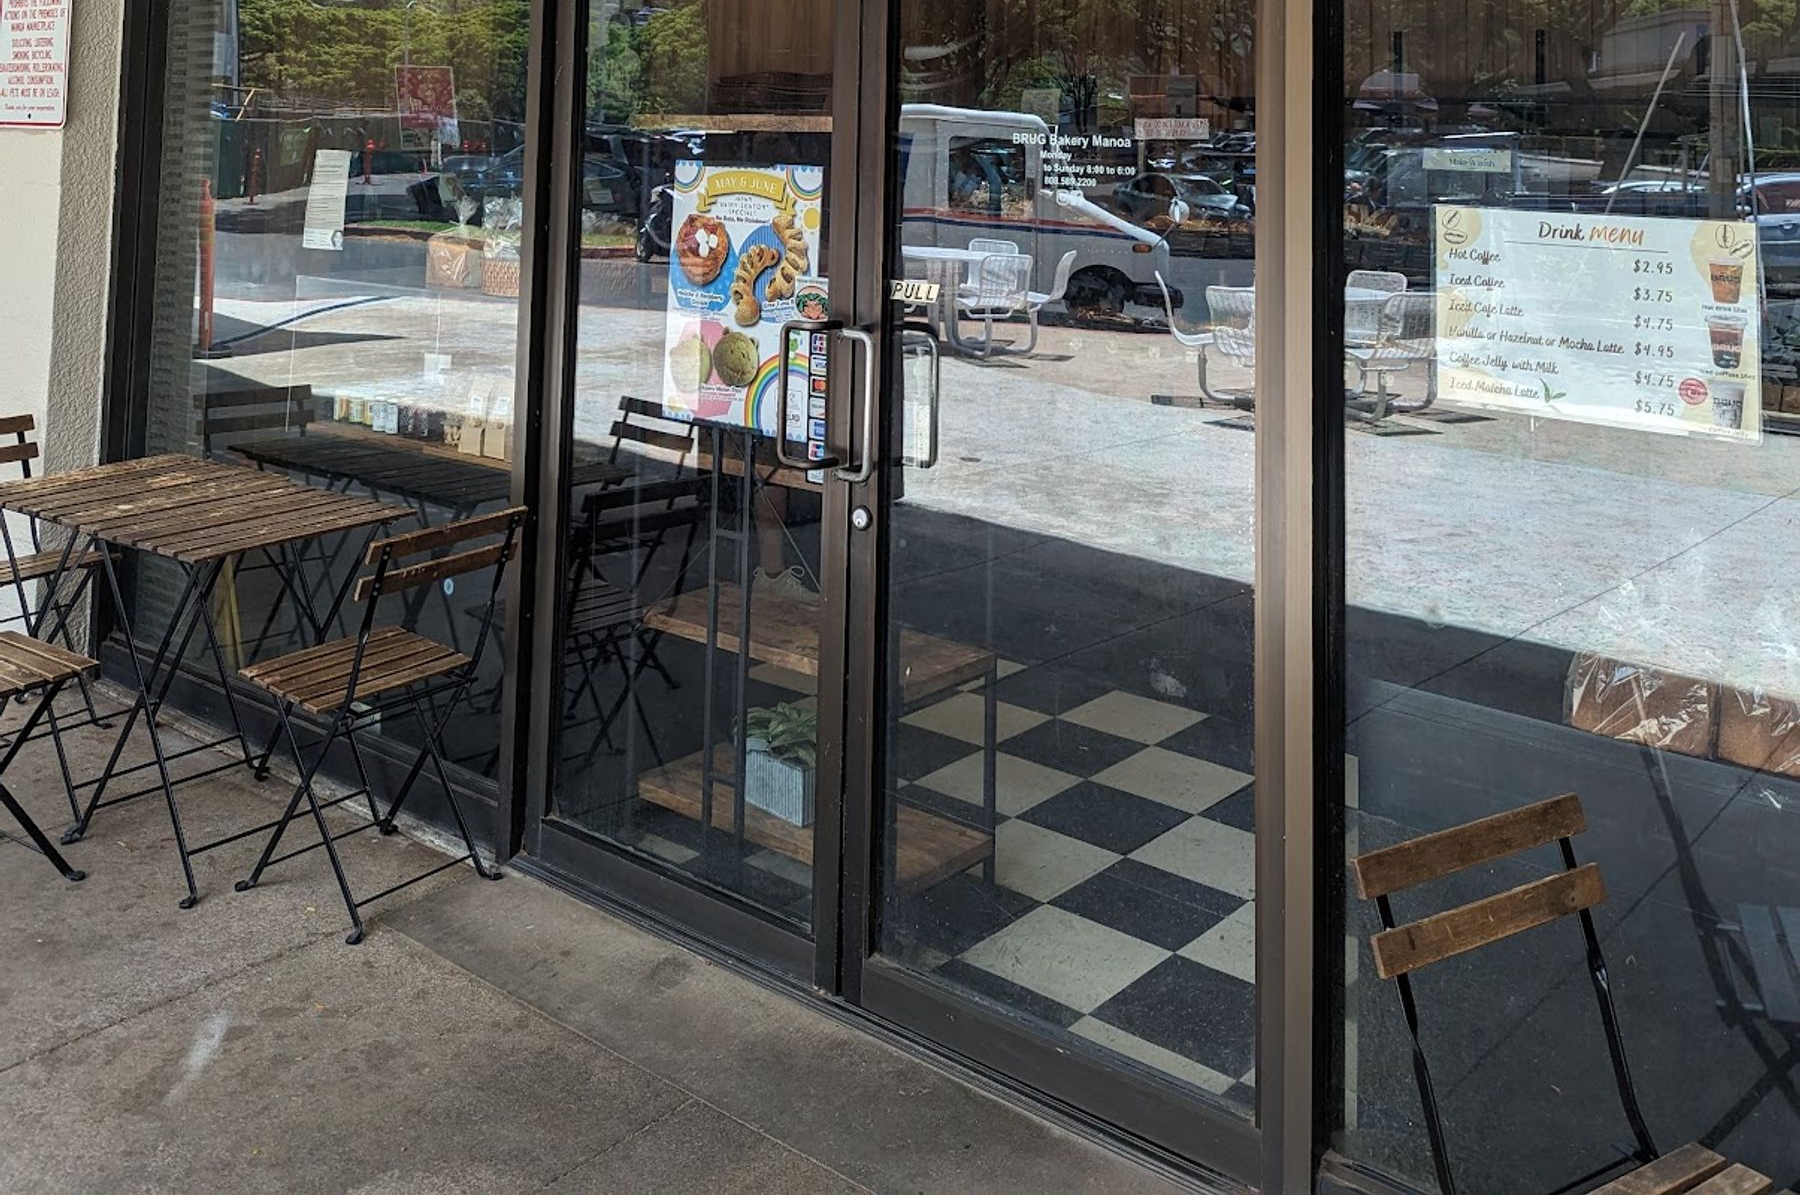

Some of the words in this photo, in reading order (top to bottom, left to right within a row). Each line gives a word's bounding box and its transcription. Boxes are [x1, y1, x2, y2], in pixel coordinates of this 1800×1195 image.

[1012, 133, 1047, 145] BRUG
[1049, 134, 1089, 149] Bakery
[1092, 135, 1132, 148] Manoa
[1040, 150, 1072, 161] Monday
[1043, 164, 1052, 172] to
[1053, 163, 1085, 175] Sunday
[1106, 166, 1115, 175] to
[715, 177, 737, 190] MAY
[740, 176, 747, 187] &
[751, 178, 777, 194] JUNE
[1538, 221, 1585, 241] Drink
[1588, 222, 1644, 246] menu
[1448, 248, 1468, 260] Hot
[1469, 249, 1501, 265] Coffee
[1633, 258, 1673, 275] $2.95
[1448, 273, 1473, 286] Iced
[1474, 275, 1506, 291] Coffee
[891, 282, 935, 302] PULL
[1633, 286, 1673, 303] $3.75
[1448, 299, 1473, 312] Iced
[1499, 305, 1525, 317] Latte
[1633, 314, 1673, 331] $4.75
[1449, 325, 1484, 339] Vanilla
[1487, 332, 1496, 340] or
[1500, 330, 1544, 346] Hazelnut
[1545, 338, 1556, 346] or
[1558, 337, 1595, 351] Mocha
[1597, 340, 1625, 354] Latte
[1634, 341, 1675, 358] $4.95
[1449, 351, 1482, 367] Coffee
[1483, 355, 1508, 371] Jelly
[1511, 360, 1533, 371] with
[1534, 361, 1559, 375] Milk
[1449, 376, 1474, 390] Iced
[1474, 379, 1512, 395] Matcha
[1514, 385, 1540, 399] Latte
[1634, 370, 1675, 388] $4.75
[1634, 399, 1675, 416] $5.75
